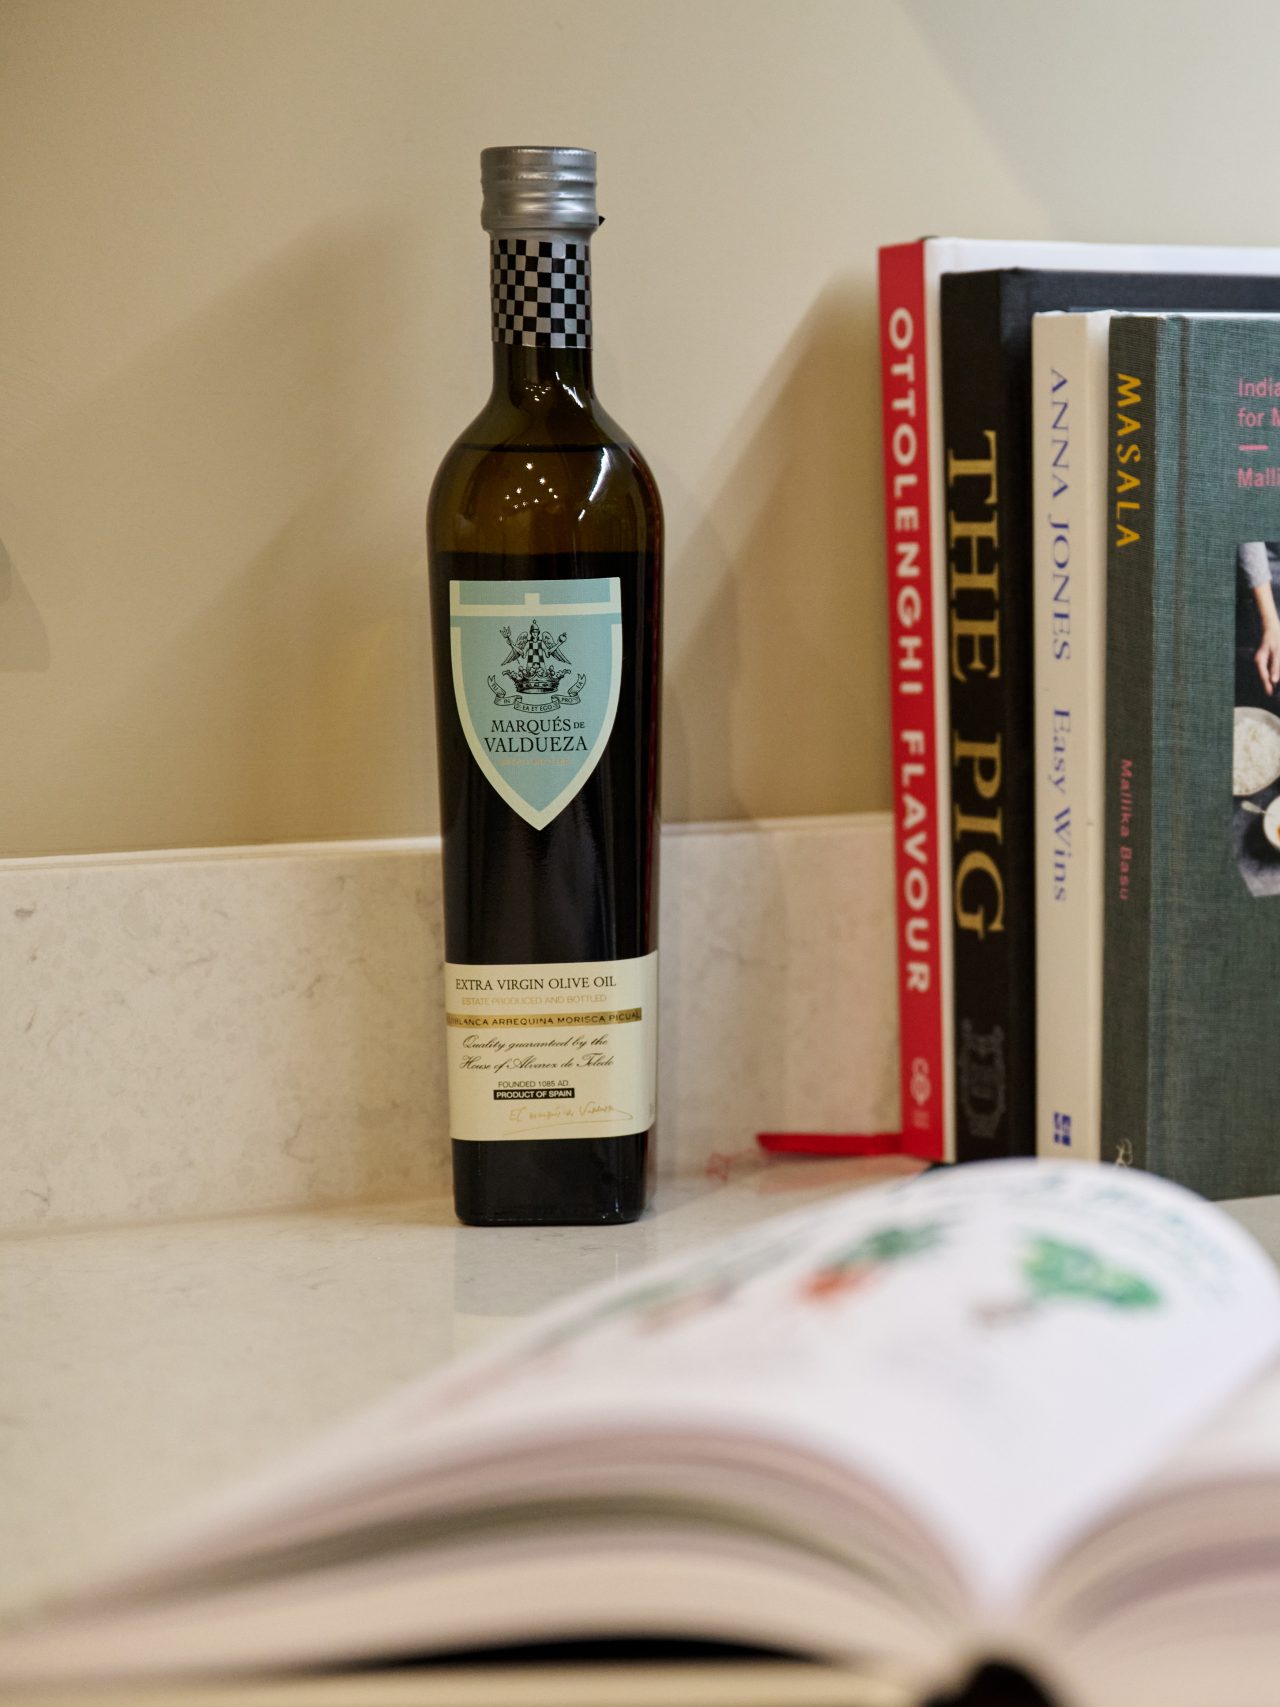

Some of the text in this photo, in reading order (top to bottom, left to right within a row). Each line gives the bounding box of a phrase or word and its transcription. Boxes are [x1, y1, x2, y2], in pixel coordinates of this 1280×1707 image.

[1237, 407, 1265, 427] for
[1115, 373, 1142, 548] MASALA
[1048, 368, 1072, 662] ANNA JONES
[889, 307, 931, 993] OTTOLENGHI FLAVOUR
[948, 430, 1005, 939] THE PIG
[491, 716, 585, 735] MARQUÉS DE
[484, 736, 588, 752] VALDUEZA
[1048, 708, 1073, 903] Easy Wins
[1119, 758, 1134, 901] Mallika Basu
[455, 975, 617, 991] EXTRA VIRGIN OLIVE OIL
[557, 1015, 606, 1024] MORISCA
[462, 1034, 506, 1053] Quality
[571, 1035, 588, 1051] by
[590, 1034, 609, 1046] the
[459, 1055, 491, 1070] House
[494, 1058, 513, 1074] of
[560, 1058, 574, 1068] de
[498, 1080, 536, 1089] FOUNDED
[496, 1090, 573, 1099] PRODUCT OF SPAIN
